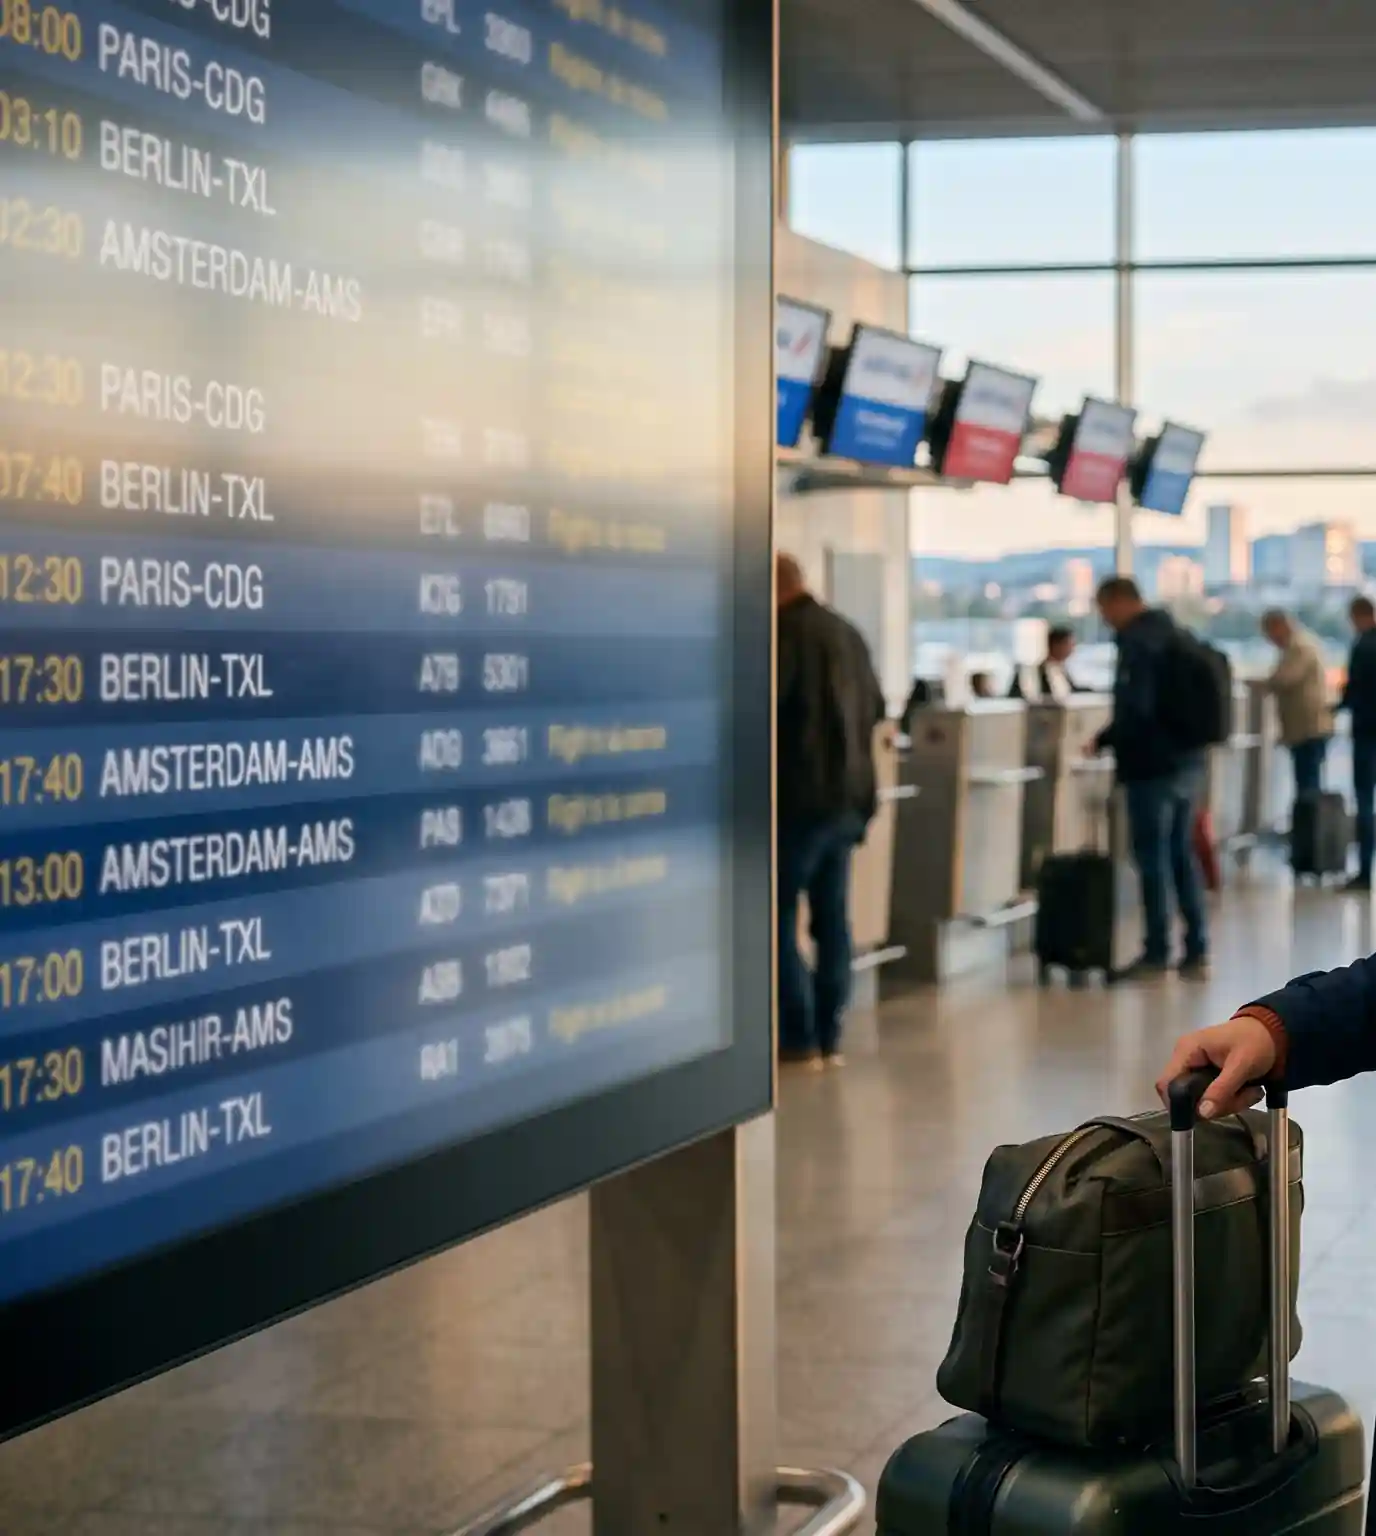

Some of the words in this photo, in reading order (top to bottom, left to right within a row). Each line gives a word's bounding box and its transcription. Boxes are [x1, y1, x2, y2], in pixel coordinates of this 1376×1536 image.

[99, 23, 265, 124] PARIS-CDG
[100, 120, 277, 215] BERLIN-TXL
[100, 219, 362, 322] AMSTERDAM-AMS
[101, 361, 265, 433] PARIS-CDG
[101, 460, 275, 522] BERLIN-TXL
[101, 556, 263, 609] PARIS-CDG
[0, 656, 83, 704] 17:30
[101, 653, 273, 702] BERLIN-TXL
[0, 753, 83, 807] 17:40
[100, 735, 355, 798] AMSTERDAM-AMS
[0, 851, 83, 907] 13:00
[100, 817, 356, 895] AMSTERDAM-AMS
[0, 948, 83, 1010] 17:00
[102, 916, 272, 990] BERLIN-TXL
[0, 1047, 84, 1113] 17:30
[102, 997, 294, 1086] MASIHIR-AMS
[0, 1145, 83, 1212] 17:40
[102, 1092, 272, 1183] BERLIN-TXL
